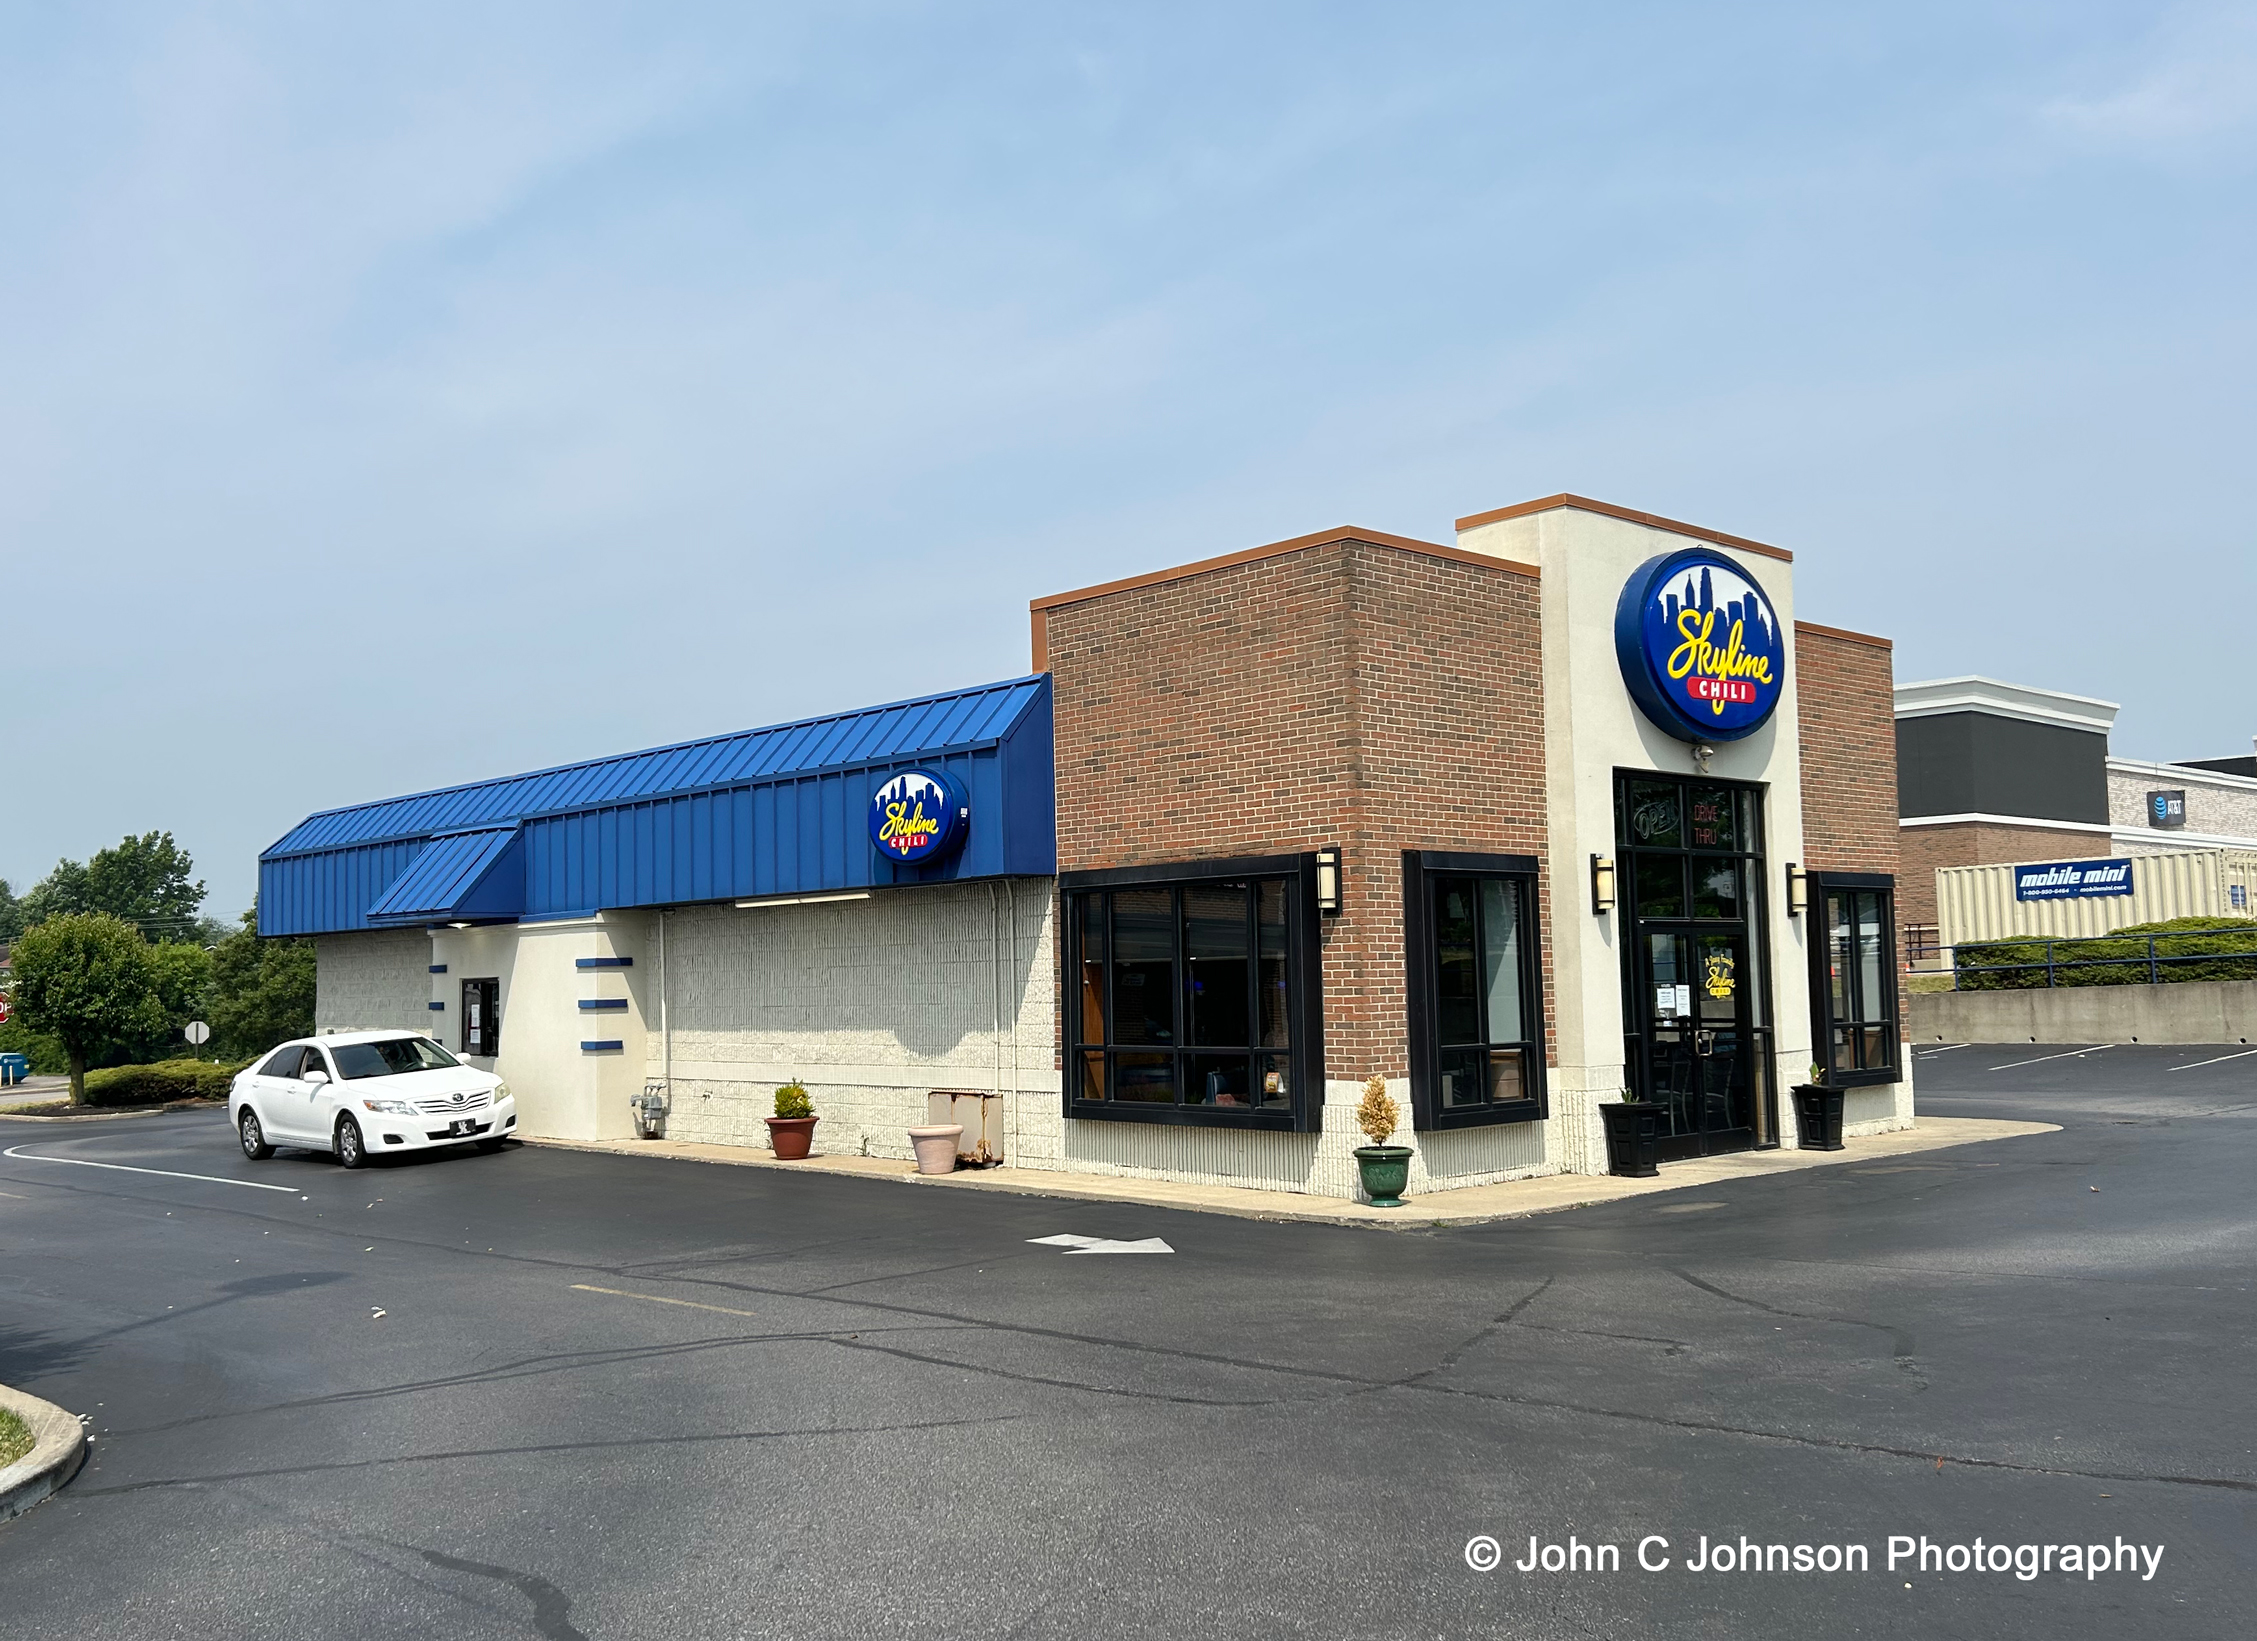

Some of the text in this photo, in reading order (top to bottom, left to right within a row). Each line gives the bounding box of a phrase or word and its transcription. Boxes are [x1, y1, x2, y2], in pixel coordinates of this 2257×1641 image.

[1667, 608, 1773, 716] Skyline
[1698, 680, 1747, 701] CHILI
[1694, 804, 1719, 823] DRIVE
[2167, 799, 2182, 815] AT&T
[879, 800, 939, 856] Skyline
[1638, 798, 1678, 840] OPEN
[890, 836, 926, 848] CHILI
[1694, 827, 1718, 845] THRU
[2020, 864, 2127, 888] mobile mini
[2079, 884, 2128, 893] mobilemini.com
